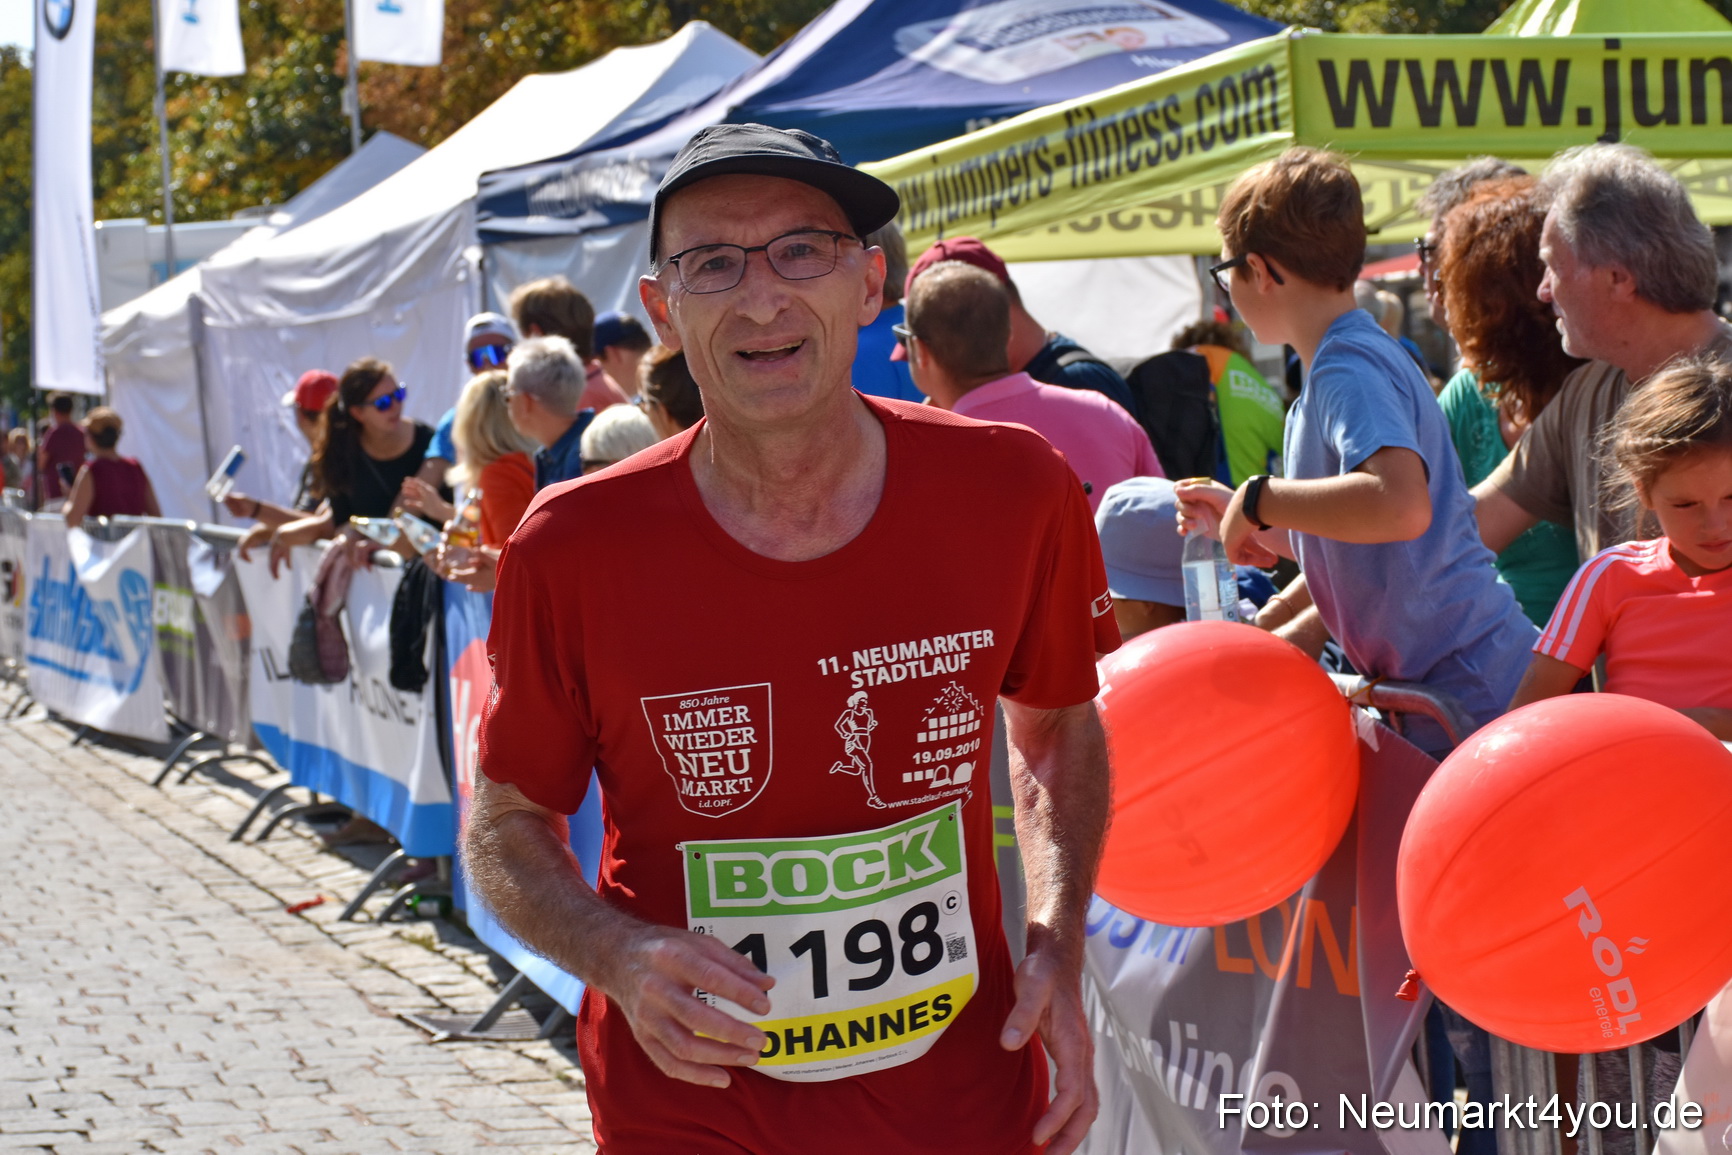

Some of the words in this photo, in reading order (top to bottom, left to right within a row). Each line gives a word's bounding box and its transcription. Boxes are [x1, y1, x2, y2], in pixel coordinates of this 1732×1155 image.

[817, 656, 849, 676] 11.
[852, 629, 995, 669] NEUMARKTER
[850, 652, 971, 689] STADTLAUF
[679, 698, 700, 710] 850
[700, 695, 730, 707] Jahre
[662, 705, 752, 732] IMMER
[662, 726, 758, 751] WIEDER
[912, 737, 981, 765] 19.09.2010
[673, 748, 752, 779] NEU
[680, 776, 754, 798] MARKT
[708, 821, 946, 906] BOCK
[945, 895, 958, 909] C
[758, 993, 954, 1059] OHANNES
